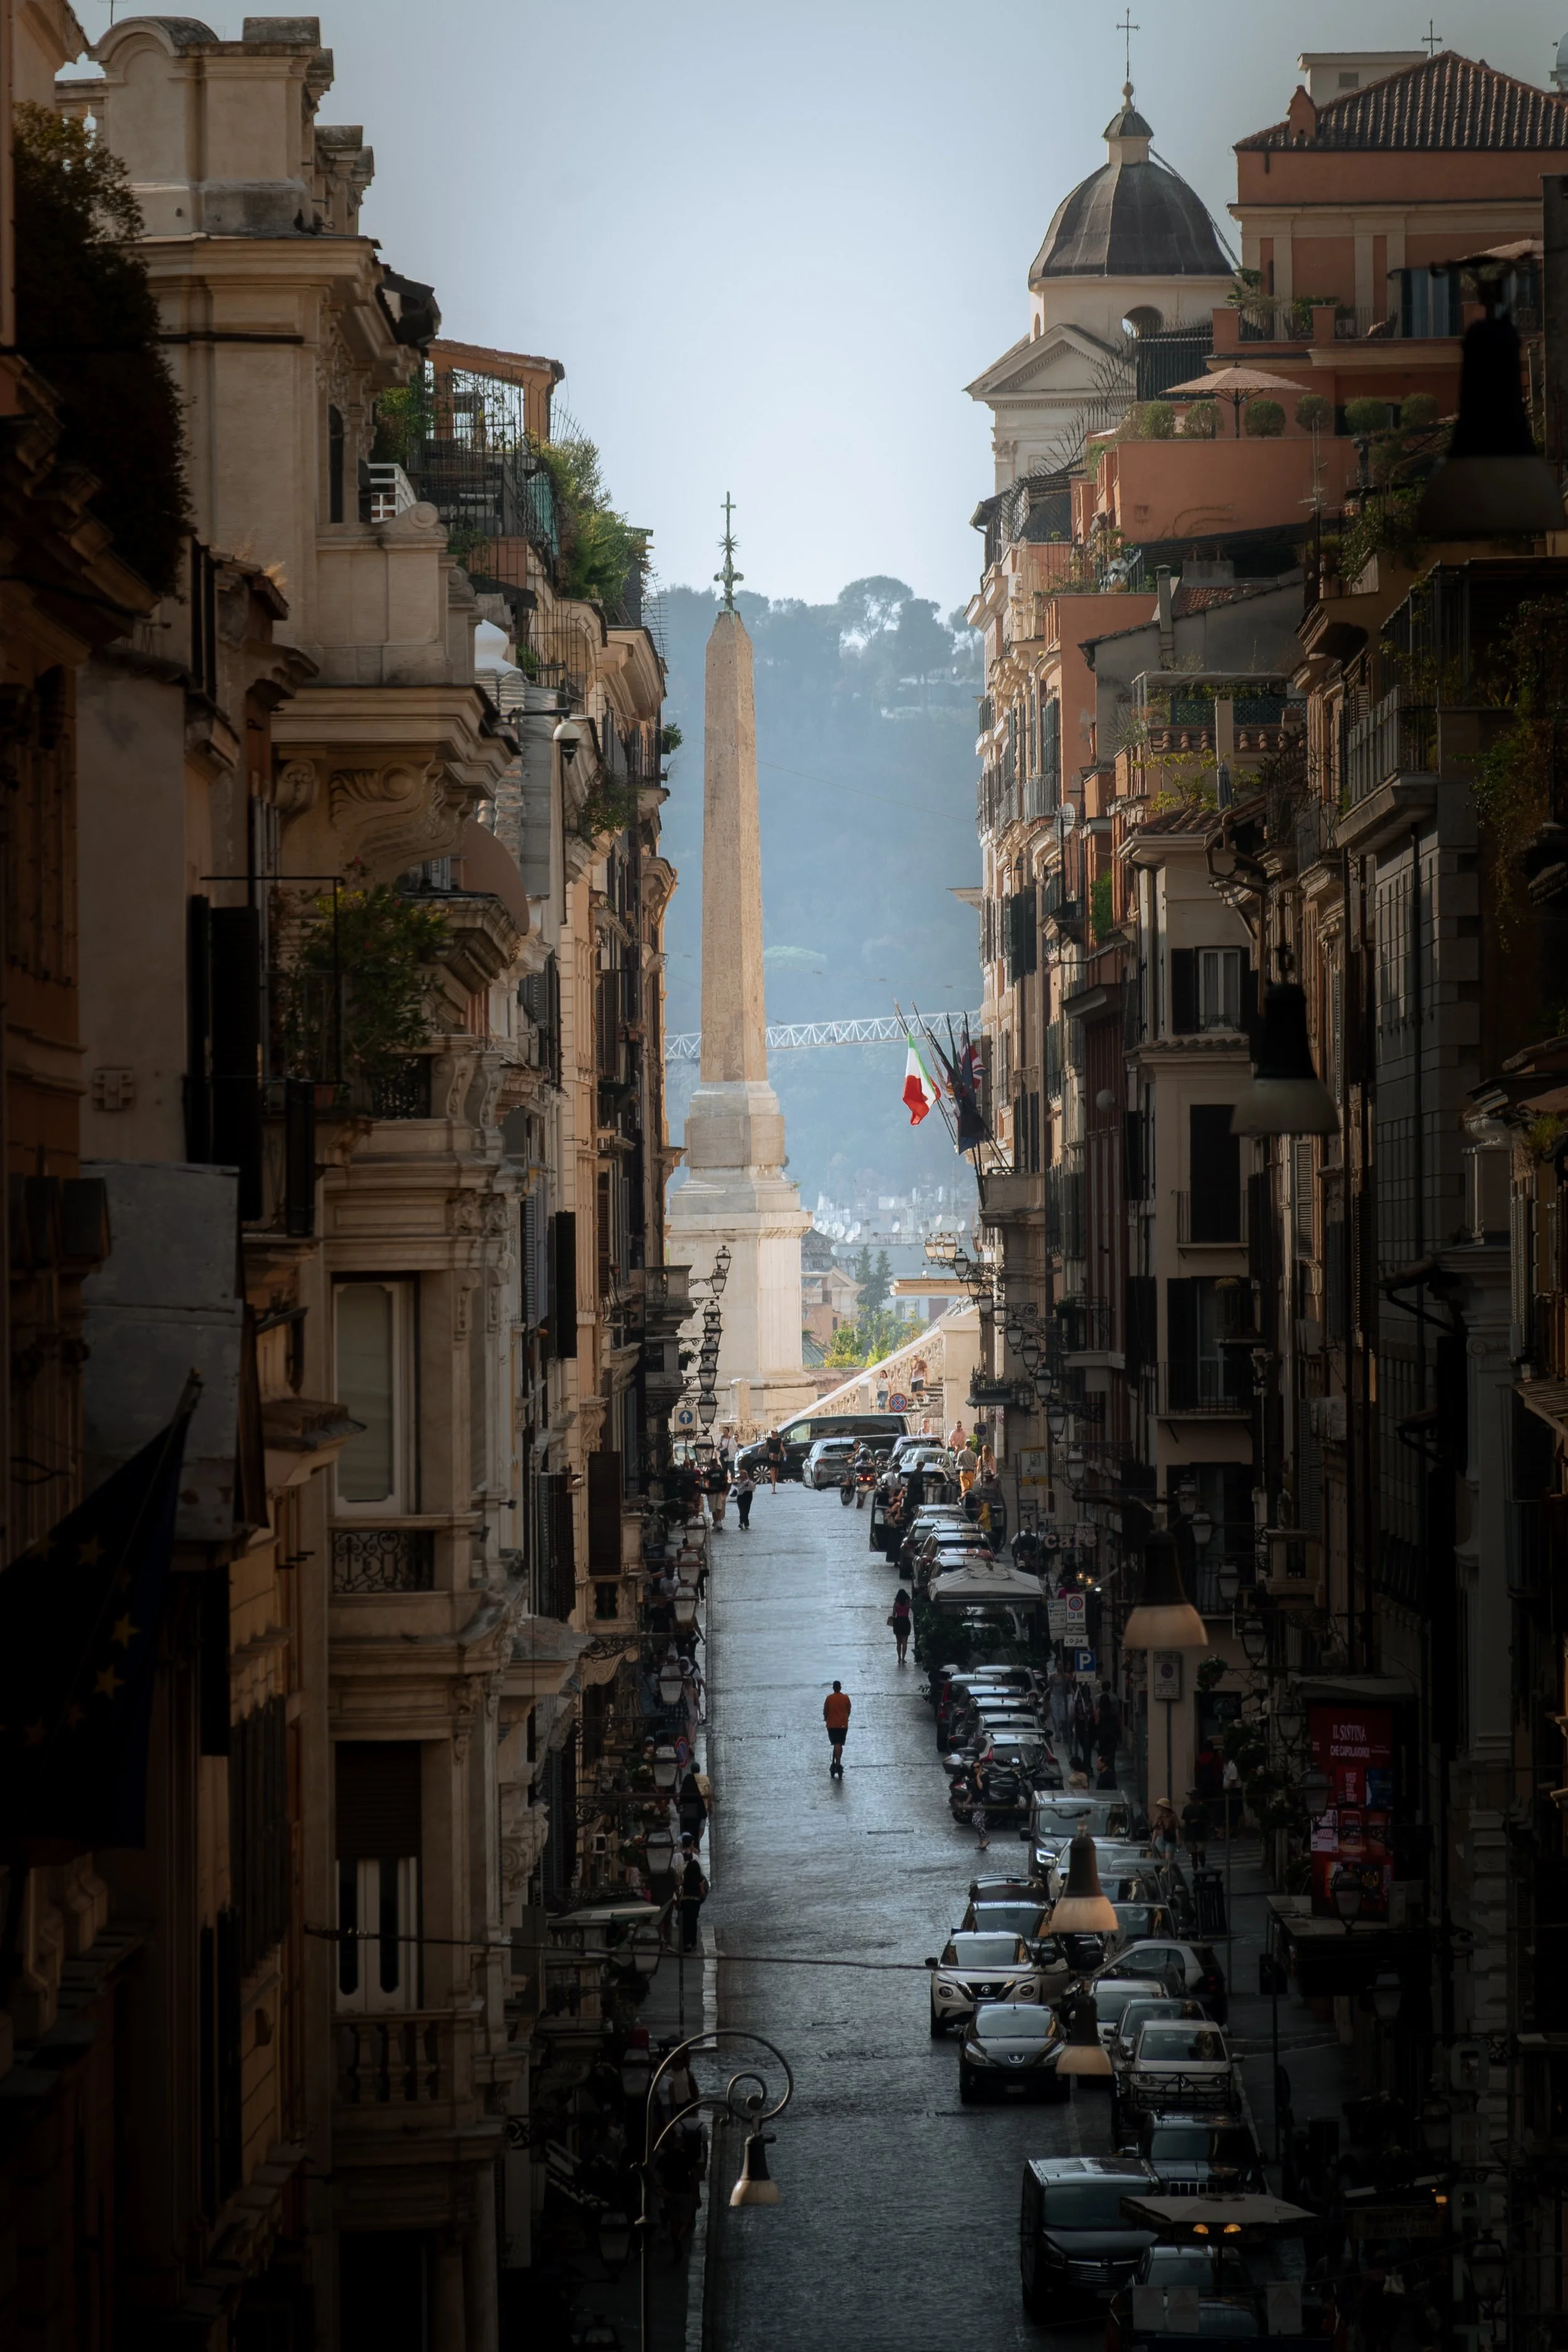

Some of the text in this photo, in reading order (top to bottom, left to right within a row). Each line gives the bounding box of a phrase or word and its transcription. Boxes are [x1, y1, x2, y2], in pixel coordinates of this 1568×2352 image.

[1079, 1653, 1091, 1670] P
[1332, 1723, 1367, 1743] IL SISTINA
[1330, 1745, 1339, 1757] CHE
[1340, 1745, 1370, 1759] CAPOLAVORO!
[1345, 1772, 1357, 1783] WEST
[1345, 1783, 1354, 1792] SIDE
[1346, 1793, 1357, 1802] STORY
